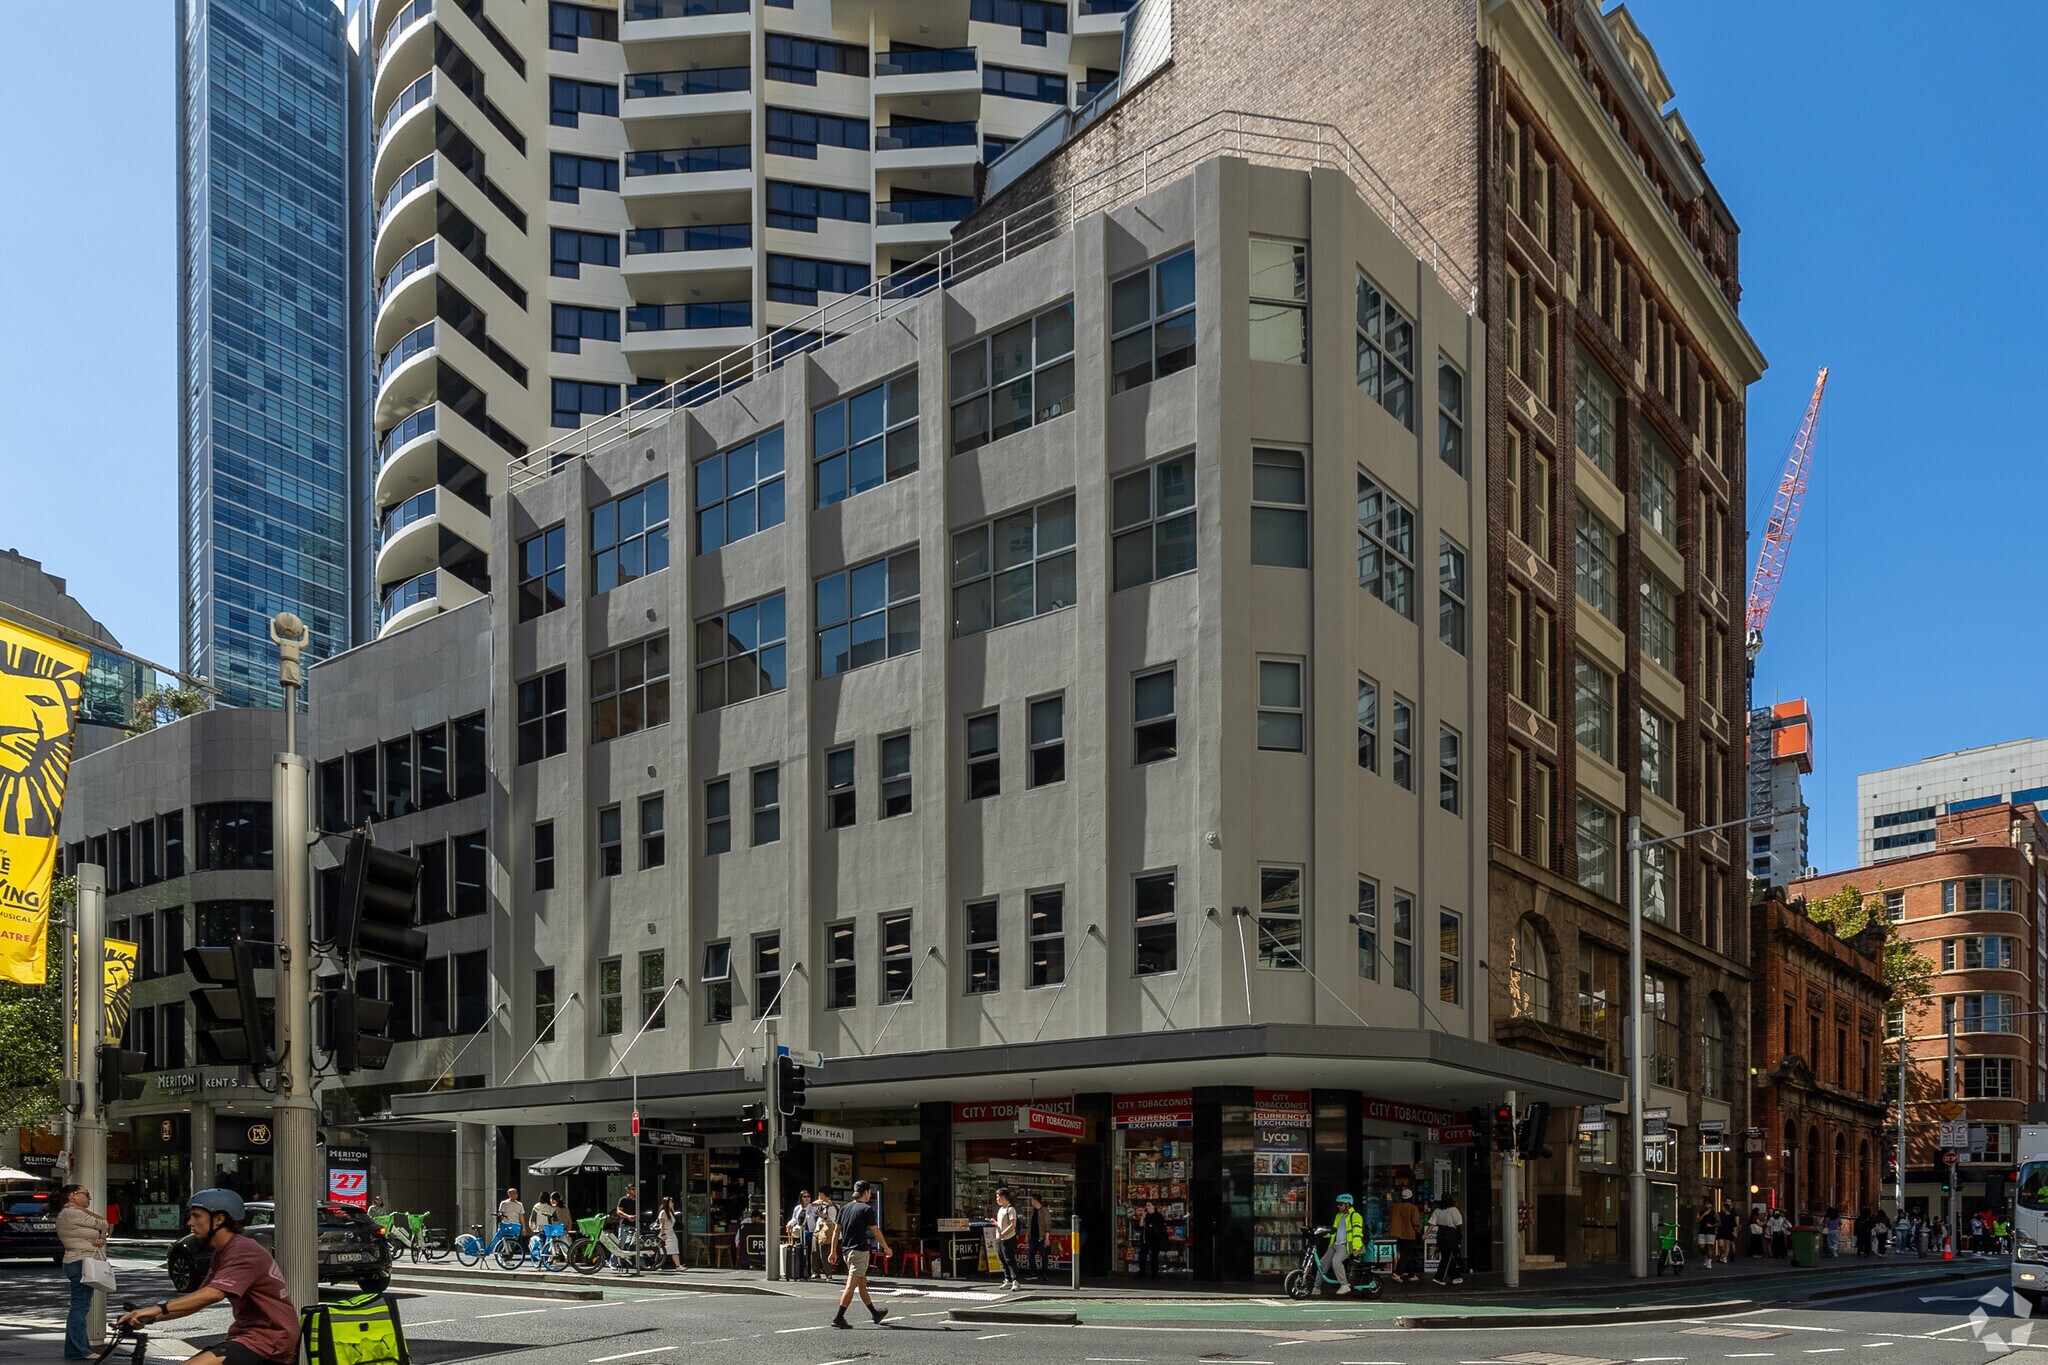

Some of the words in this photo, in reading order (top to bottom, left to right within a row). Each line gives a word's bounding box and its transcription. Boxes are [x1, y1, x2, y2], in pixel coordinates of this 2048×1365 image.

[0, 879, 39, 907] ING
[158, 1074, 195, 1088] MERITON
[205, 1078, 229, 1088] KENT
[1117, 1101, 1135, 1110] CITY
[1138, 1097, 1193, 1108] TOBACCONIST
[1255, 1101, 1308, 1109] TOBACCONIST
[962, 1106, 987, 1118] CITY
[991, 1102, 1071, 1117] TOBAONIST
[1369, 1102, 1391, 1118] CITY
[1394, 1106, 1453, 1127] TOBACCONIST
[1031, 1113, 1045, 1124] CITY
[1046, 1115, 1082, 1129] TOBACCONIST
[1128, 1114, 1179, 1122] CURRENCY
[608, 1124, 617, 1133] 86
[1128, 1121, 1179, 1129] EXCHANGE
[801, 1127, 822, 1136] PRIK
[825, 1130, 845, 1139] THAI
[1262, 1131, 1289, 1143] Lyca
[1444, 1130, 1464, 1139] CITY
[329, 1150, 368, 1158] MERITON
[955, 1244, 973, 1255] PRIK
